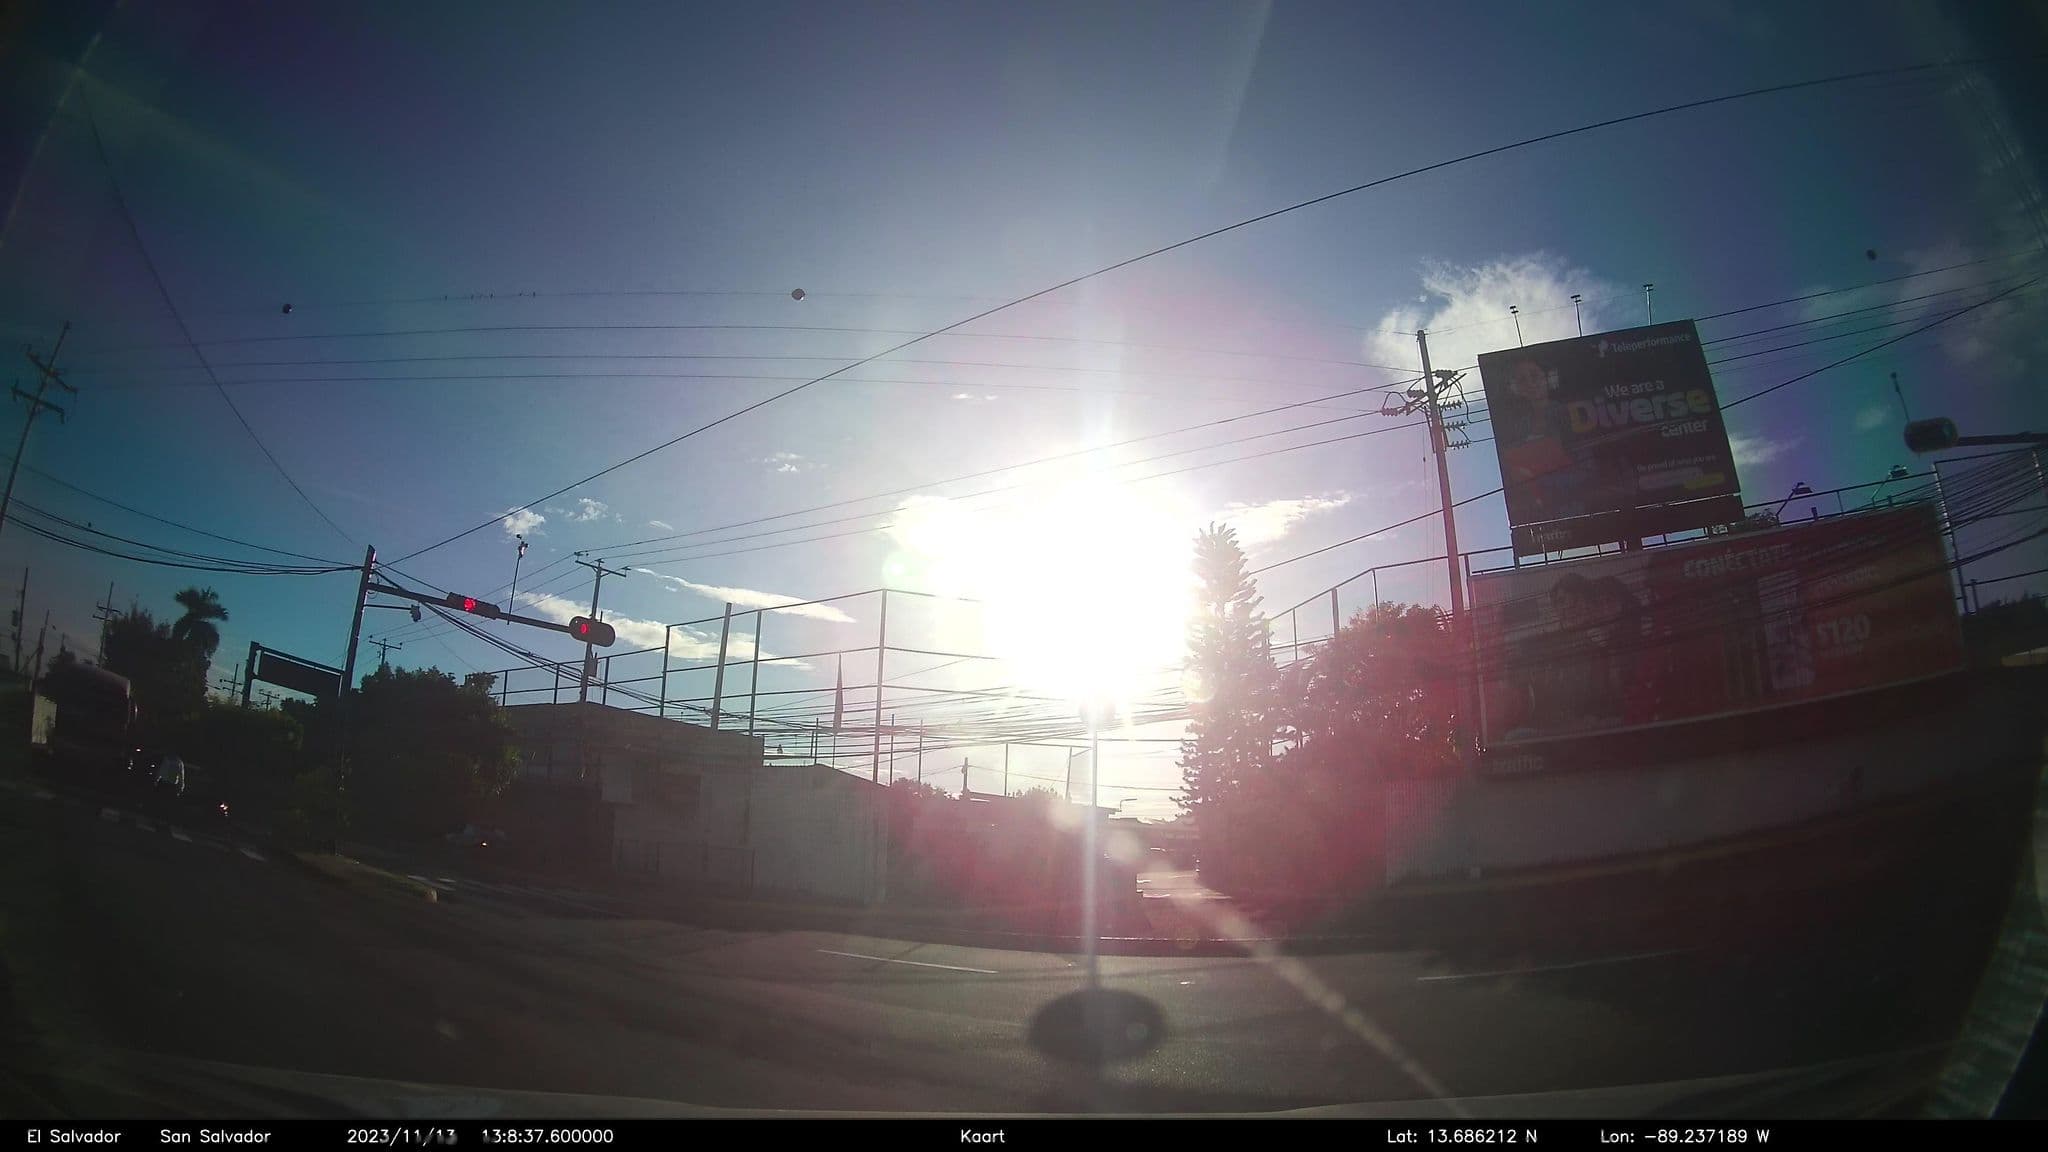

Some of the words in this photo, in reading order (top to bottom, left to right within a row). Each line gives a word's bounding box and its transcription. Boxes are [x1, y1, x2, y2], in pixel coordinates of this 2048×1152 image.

[1611, 333, 1690, 354] Teleperformance
[1605, 383, 1630, 398] We
[1632, 380, 1654, 394] are
[1655, 379, 1665, 390] a
[1568, 388, 1711, 433] Diverse
